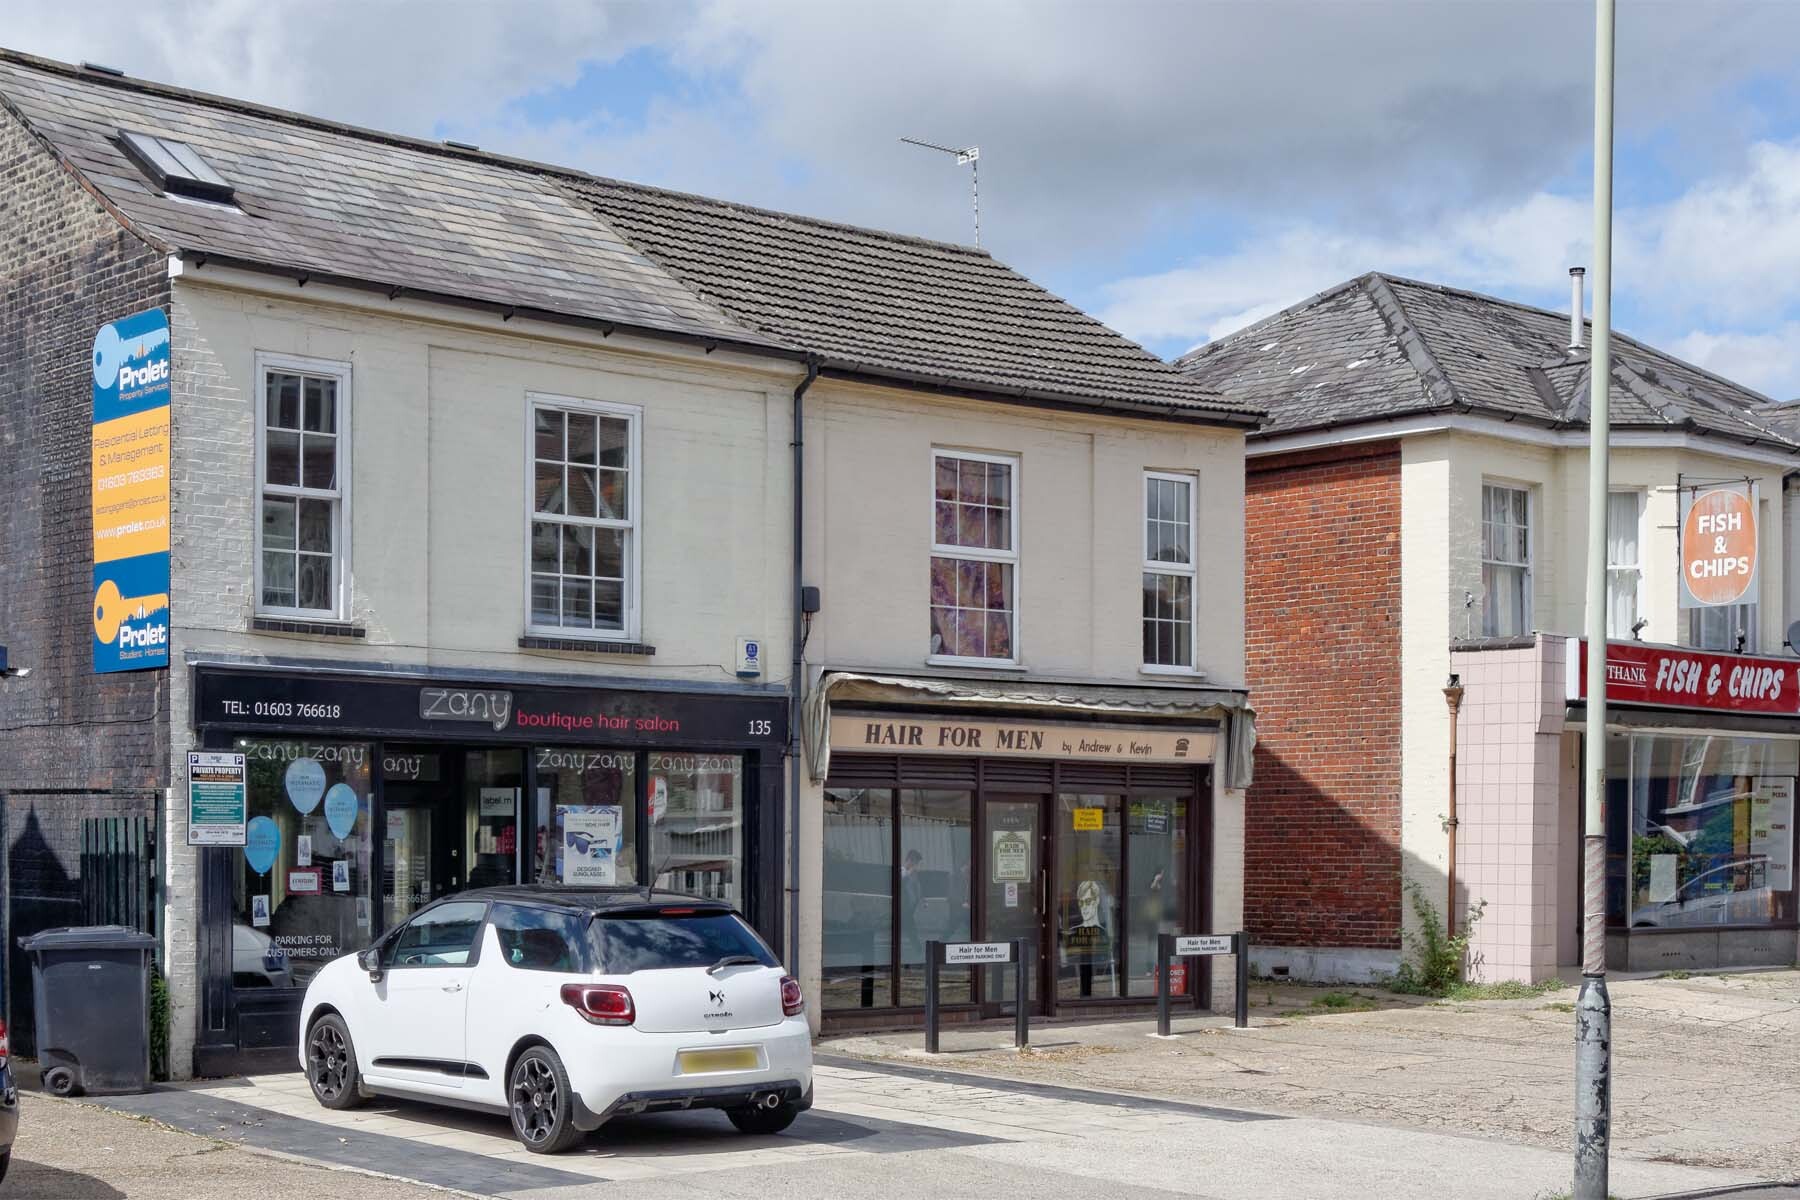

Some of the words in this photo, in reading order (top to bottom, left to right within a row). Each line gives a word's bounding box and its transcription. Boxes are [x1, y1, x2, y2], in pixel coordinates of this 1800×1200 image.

[119, 358, 168, 390] Prolet
[96, 515, 167, 539] www.prolet.co.uk
[1698, 512, 1742, 534] FISH
[1714, 535, 1728, 554] &
[1690, 556, 1749, 578] CHIPS
[119, 622, 166, 648] Prolet
[1607, 665, 1647, 682] THANK
[1655, 658, 1702, 694] FISH
[1706, 663, 1721, 695] &
[1728, 665, 1785, 700] CHIPS
[222, 700, 250, 714] TEL:
[254, 701, 292, 716] 01603
[296, 704, 341, 718] 766618
[423, 689, 511, 729] zany
[516, 709, 593, 732] boutique
[598, 712, 630, 730] hair
[634, 715, 680, 732] salon
[748, 720, 772, 735] 135
[864, 723, 923, 746] HAIR
[937, 726, 982, 748] FOR
[996, 729, 1045, 751] MEN
[1062, 740, 1072, 755] by
[1078, 739, 1111, 753] Andrew
[1129, 741, 1152, 755] Kevin
[311, 745, 364, 769] zany
[384, 756, 421, 779] any
[537, 752, 586, 775] zany
[587, 754, 635, 776] zany
[649, 756, 695, 777] zany
[192, 766, 214, 774] PRIVATE
[214, 767, 242, 775] PROPERTY
[275, 935, 313, 945] PARKING
[315, 935, 333, 944] FOR
[265, 947, 318, 957] CUSTOMERS
[319, 946, 342, 957] ONLY
